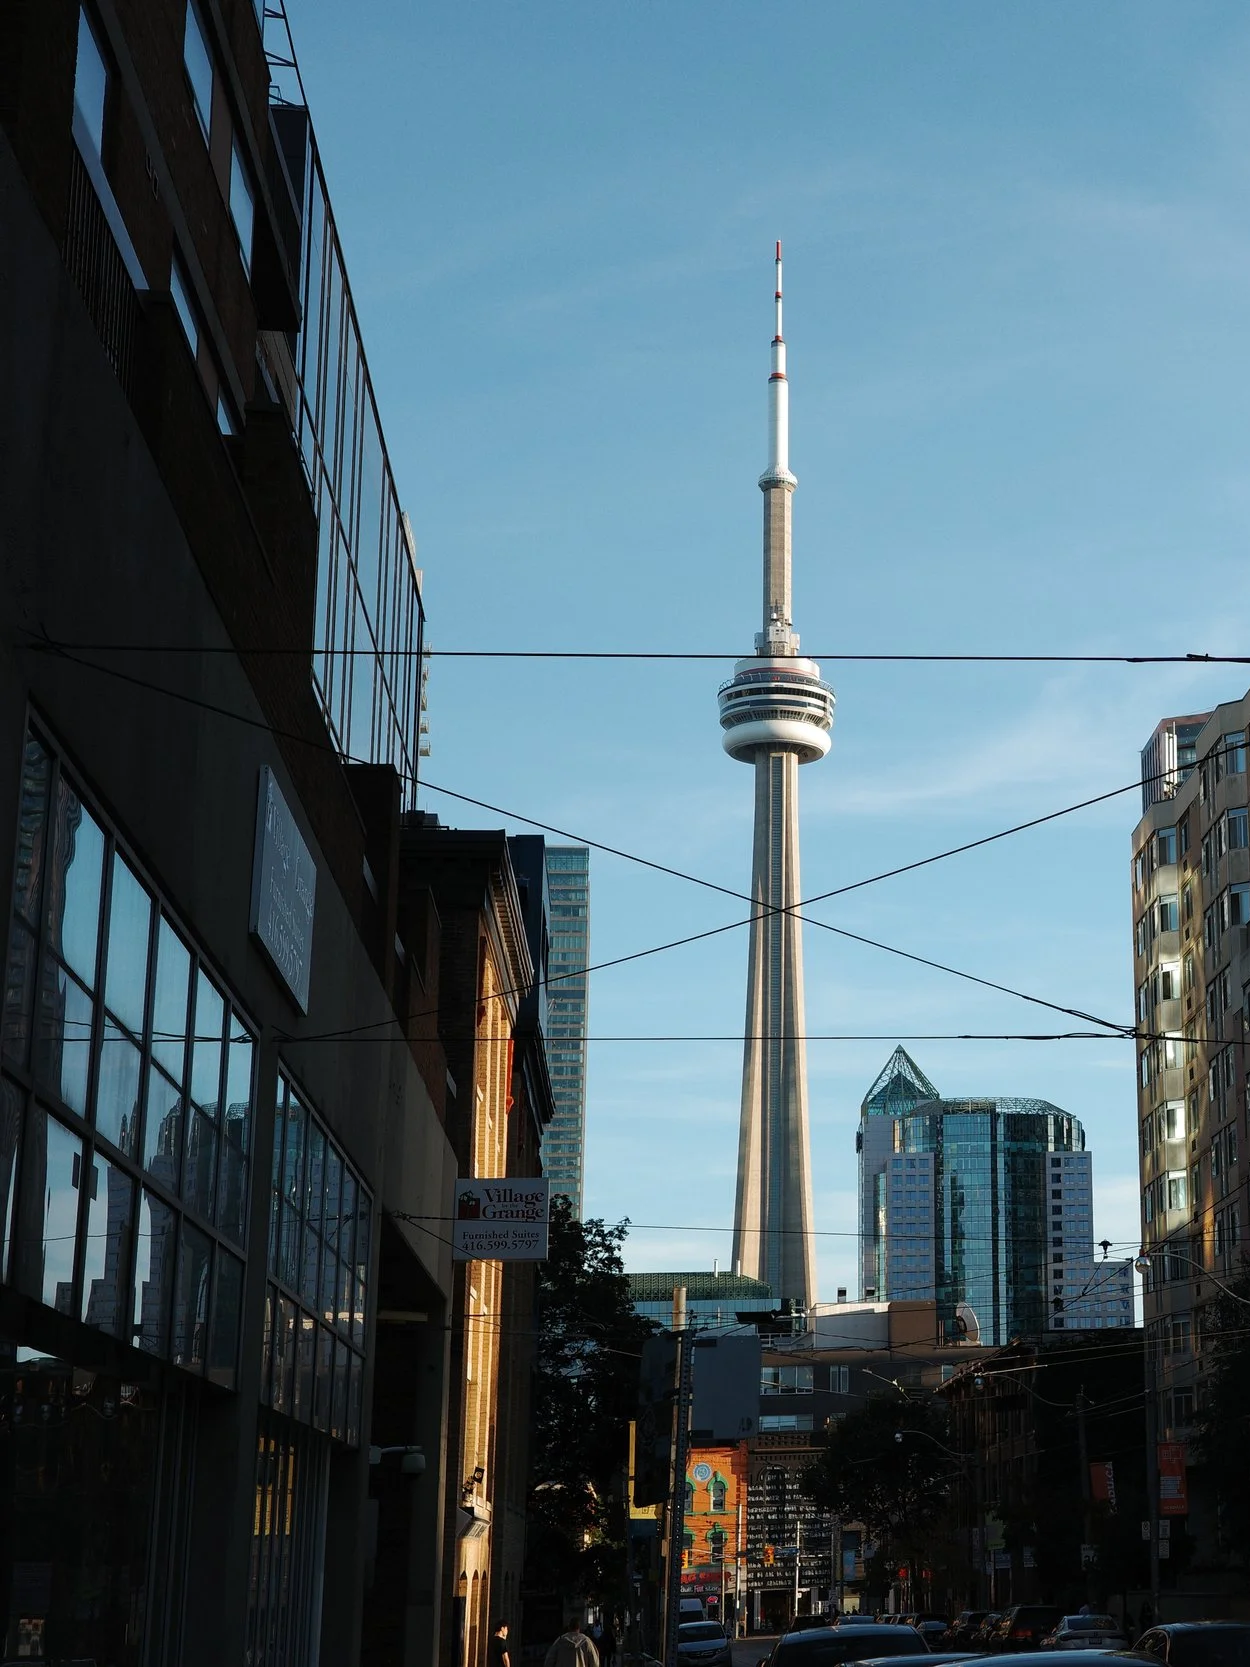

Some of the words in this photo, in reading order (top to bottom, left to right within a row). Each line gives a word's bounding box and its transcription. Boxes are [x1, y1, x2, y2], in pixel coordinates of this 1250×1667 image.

[483, 1188, 545, 1208] Village
[482, 1204, 545, 1223] Grange
[462, 1230, 509, 1239] Furnished
[512, 1229, 540, 1239] Suites
[462, 1239, 540, 1251] 416.599.5797
